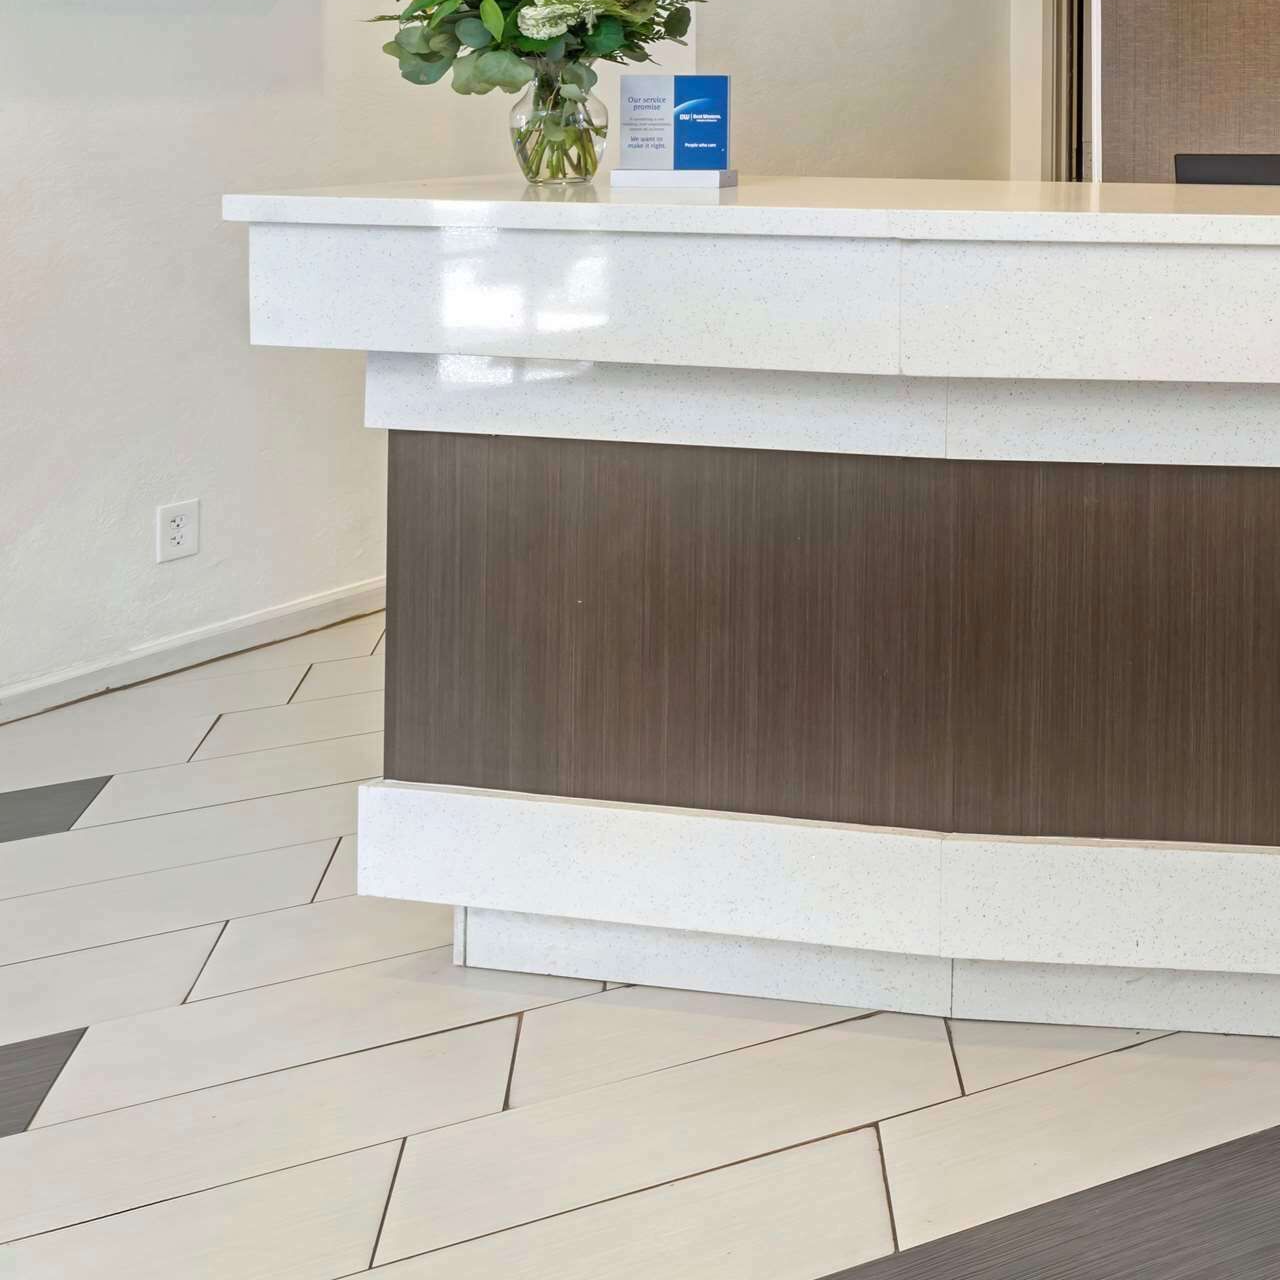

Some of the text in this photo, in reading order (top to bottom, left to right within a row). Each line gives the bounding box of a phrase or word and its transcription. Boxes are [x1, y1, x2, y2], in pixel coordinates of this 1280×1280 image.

[627, 96, 667, 104] Our service
[633, 103, 661, 111] promise
